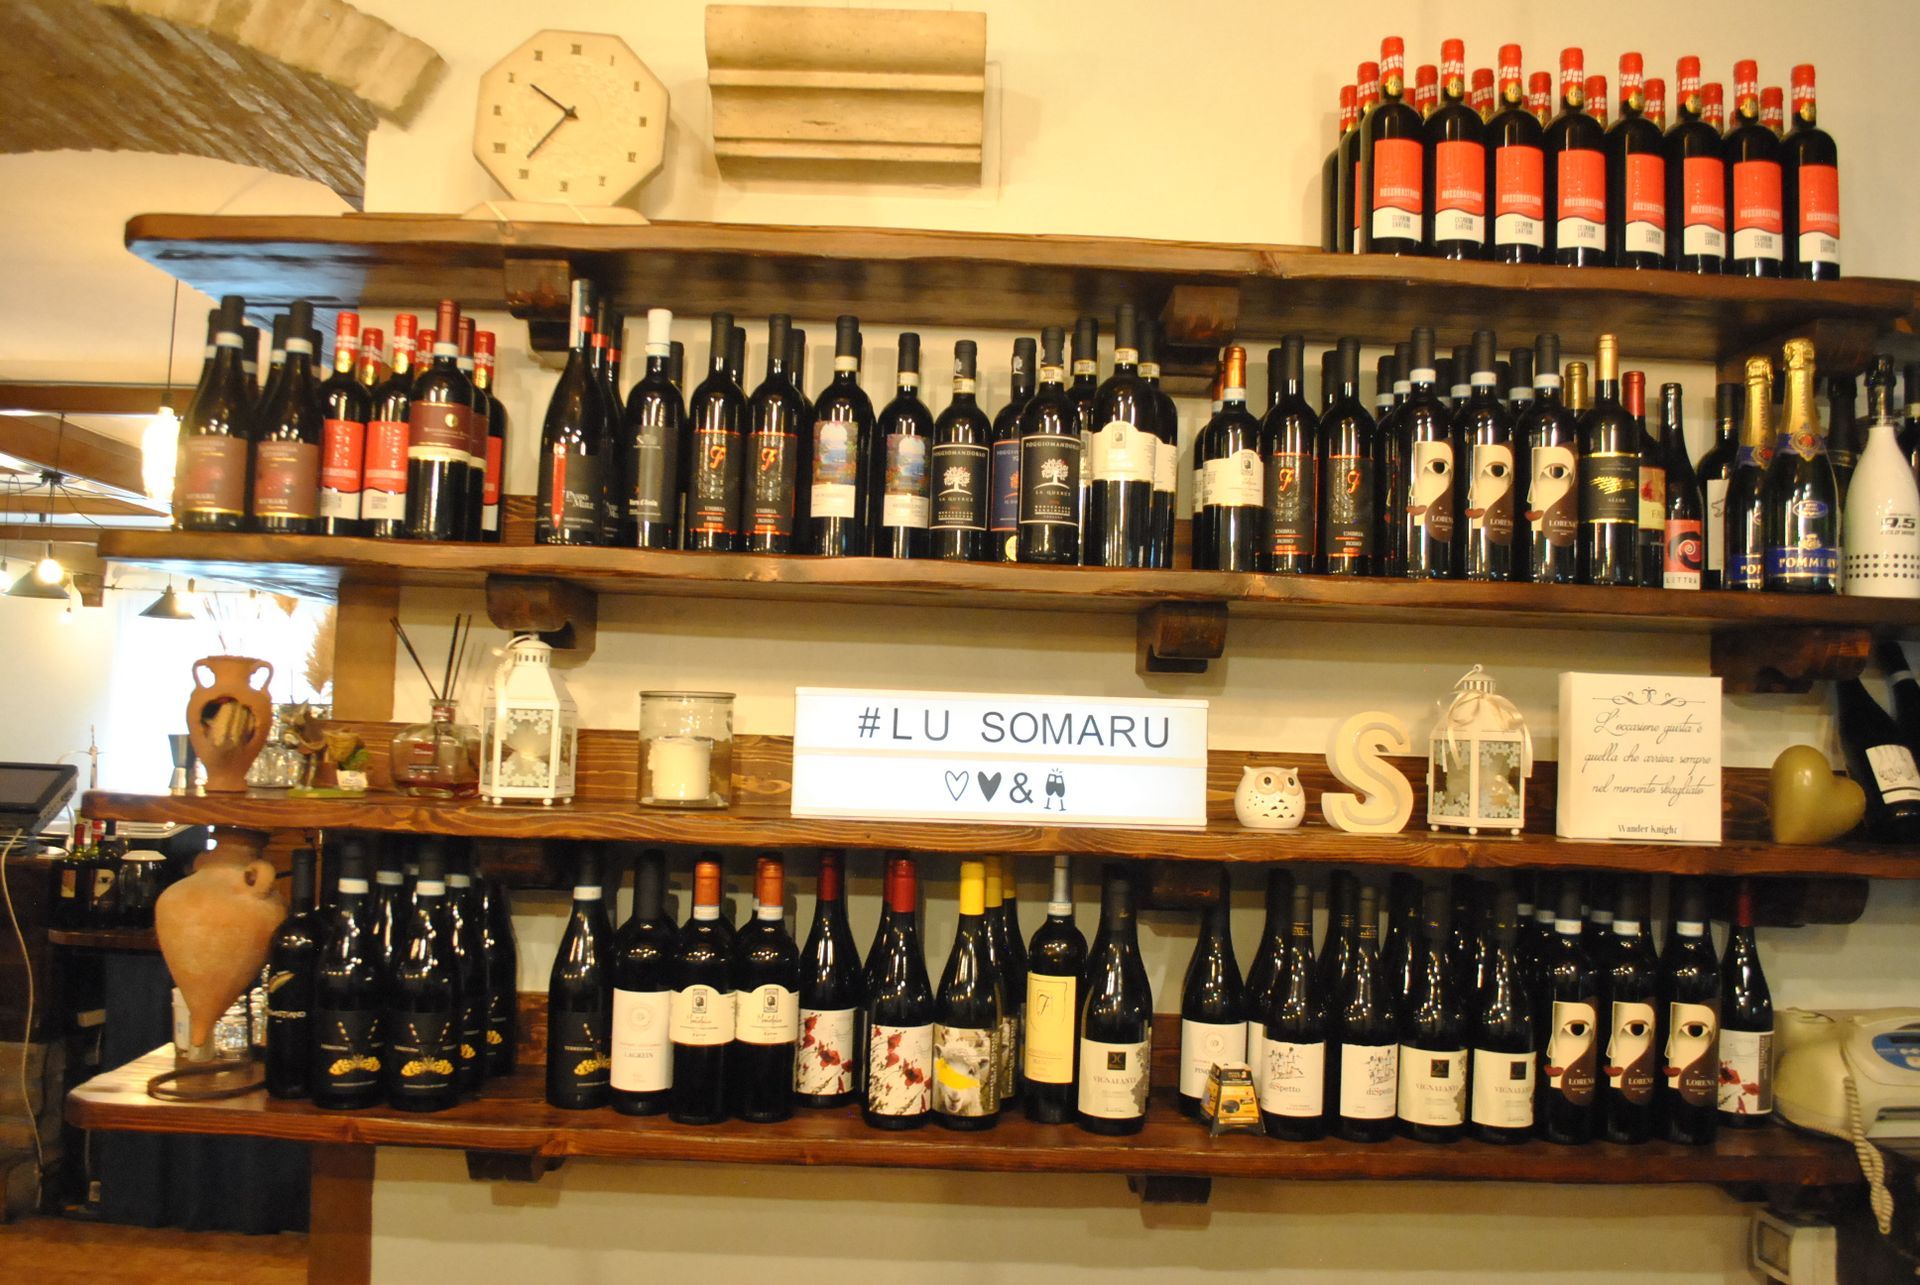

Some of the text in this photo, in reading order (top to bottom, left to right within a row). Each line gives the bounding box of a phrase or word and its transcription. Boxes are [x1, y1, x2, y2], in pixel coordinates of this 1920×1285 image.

[980, 711, 1170, 748] SOMARU
[1623, 744, 1640, 763] che
[1009, 772, 1034, 804] &
[1592, 774, 1615, 793] nel
